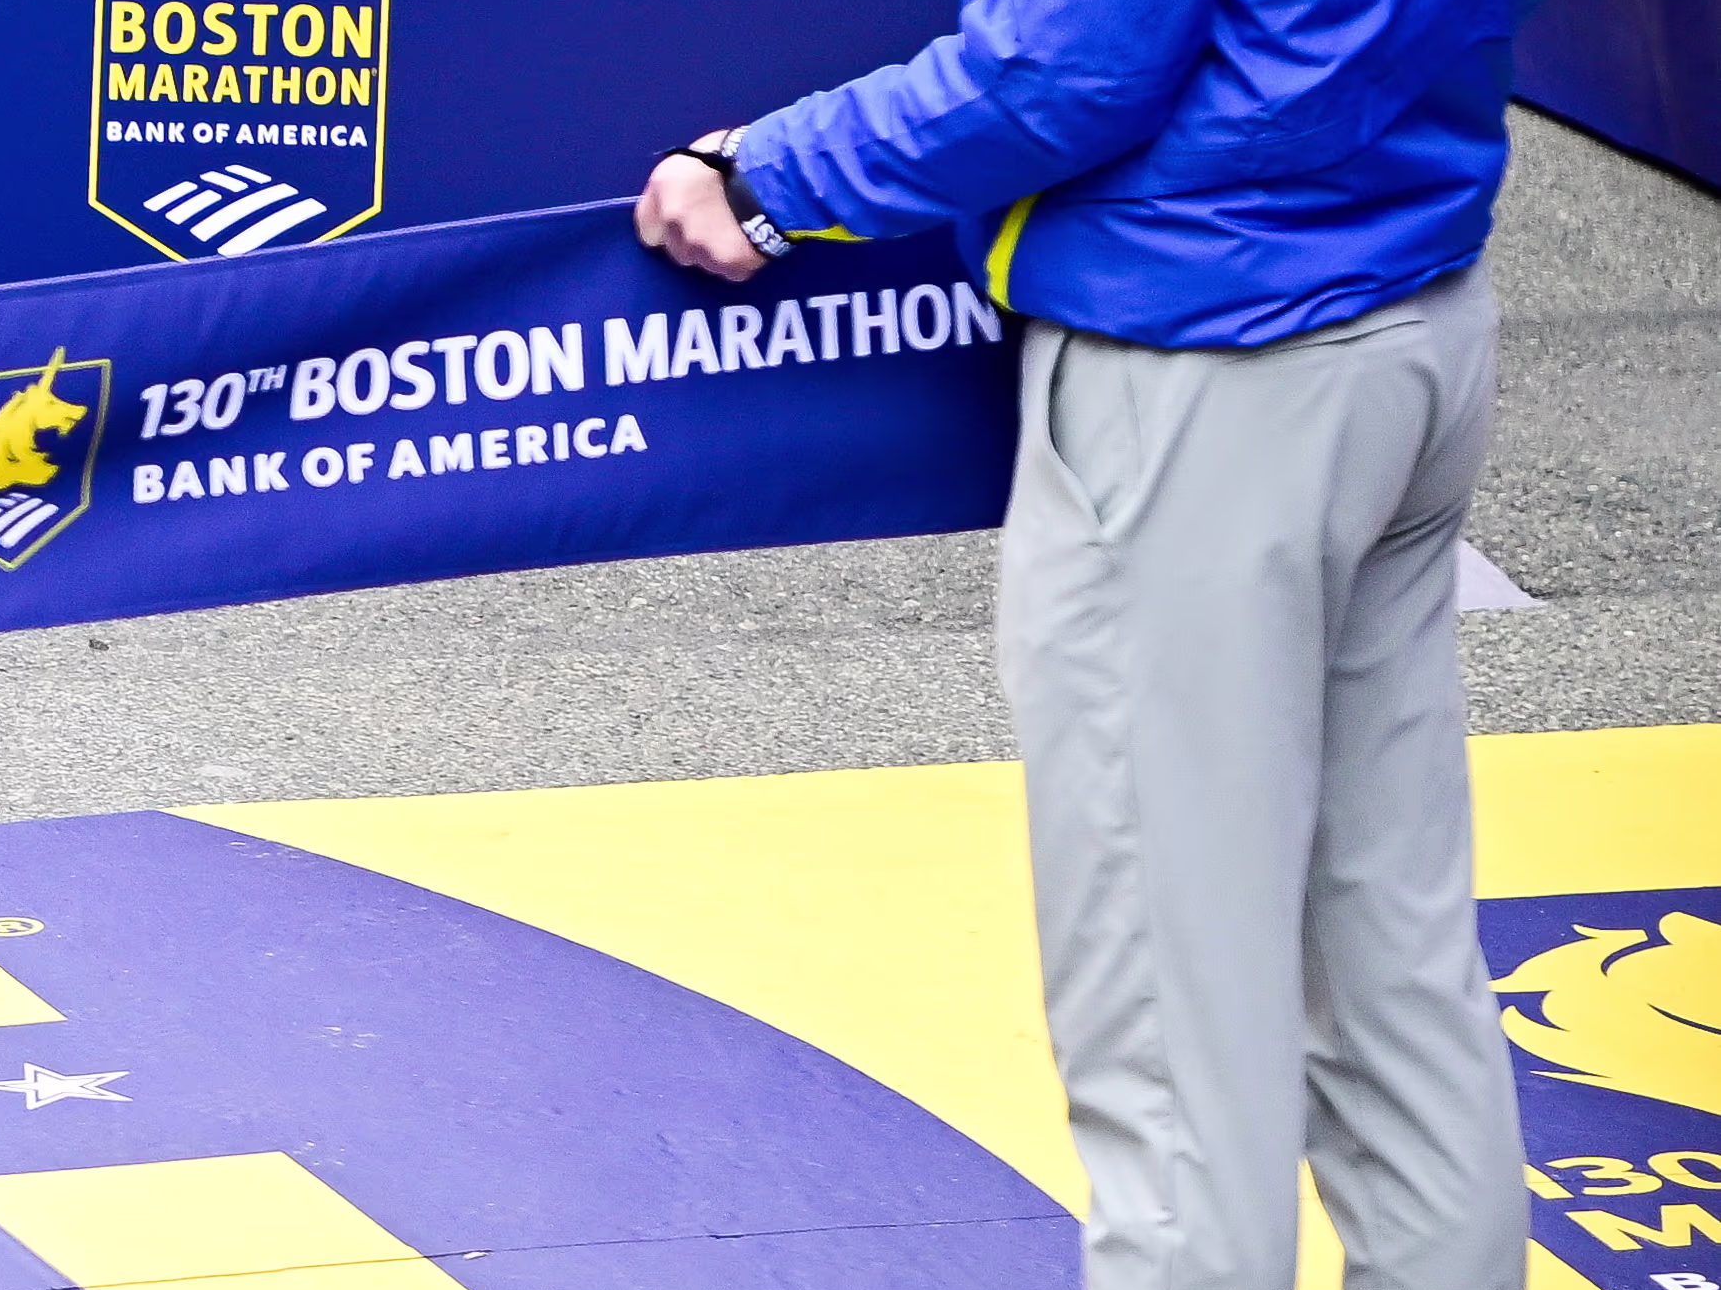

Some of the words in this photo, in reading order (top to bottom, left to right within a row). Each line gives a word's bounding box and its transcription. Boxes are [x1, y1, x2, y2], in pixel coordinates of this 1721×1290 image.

[111, 2, 372, 57] BOSTON
[109, 64, 370, 105] MARATHON
[107, 121, 185, 143] BANK
[193, 123, 230, 143] OF
[236, 124, 367, 146] AMERICA
[290, 323, 584, 420] BOSTON
[604, 284, 1001, 386] MARATHON
[133, 452, 289, 503] BANK
[302, 443, 375, 487] OF
[388, 414, 647, 479] AMERICA
